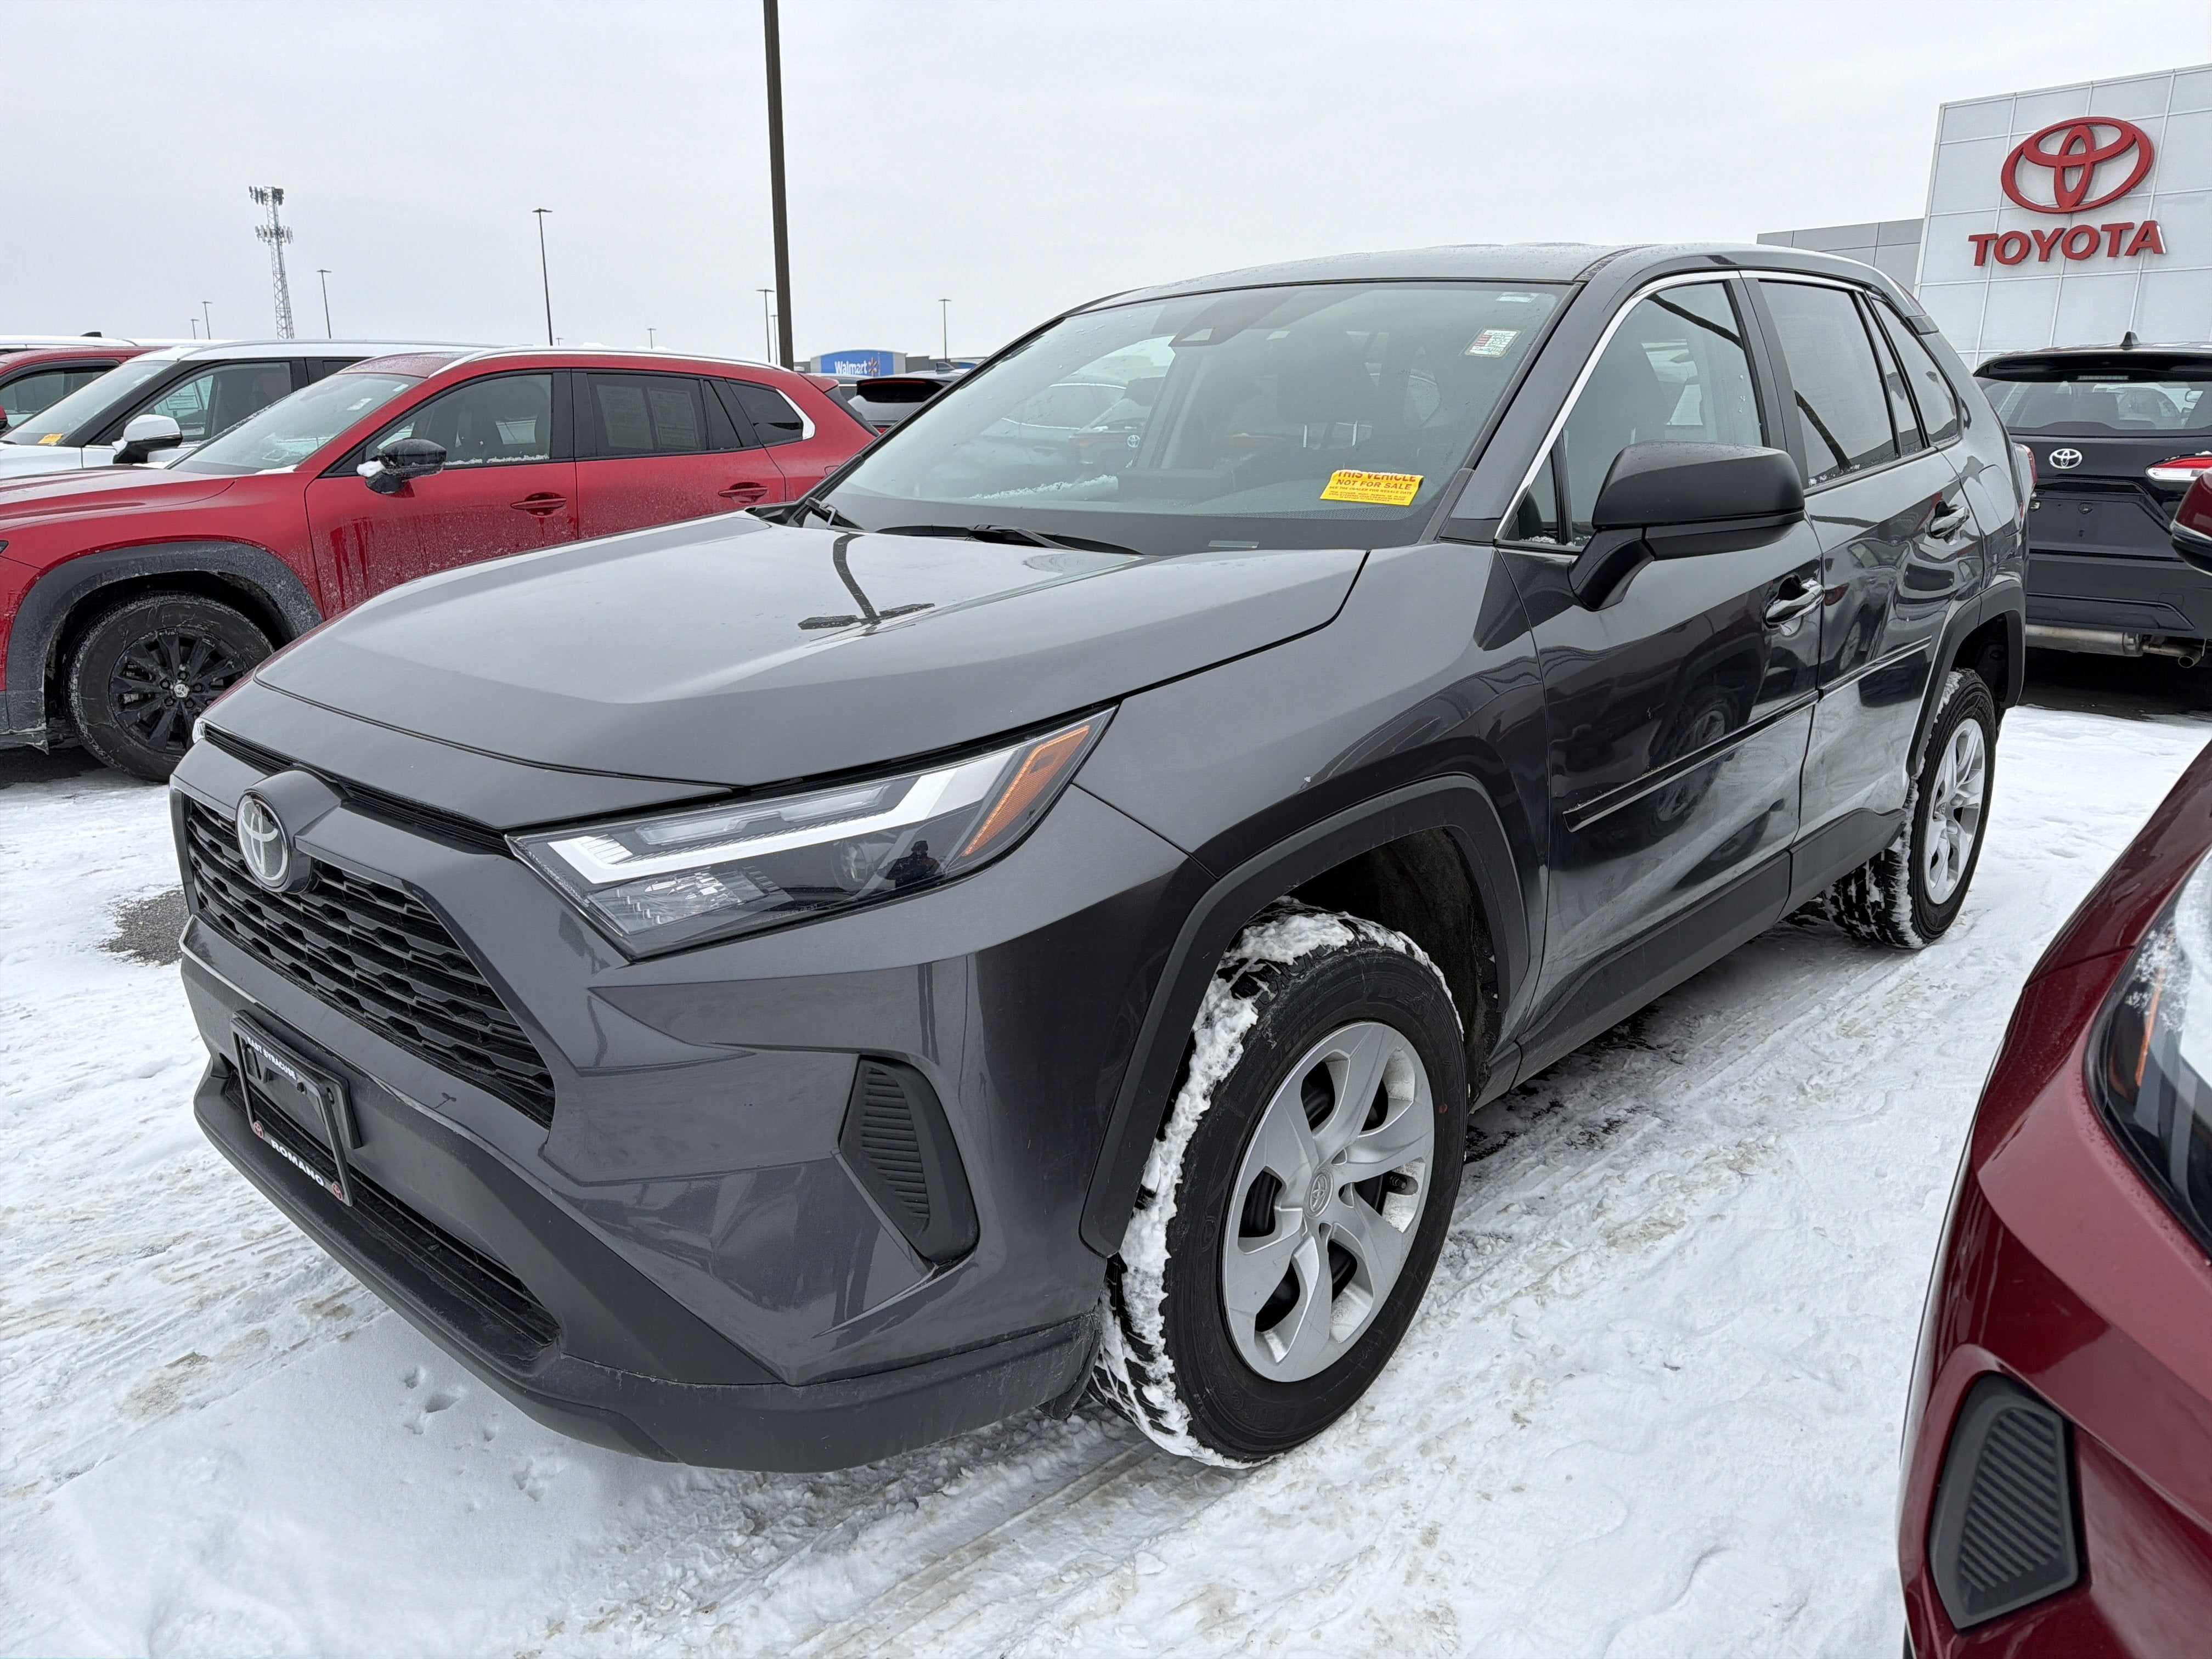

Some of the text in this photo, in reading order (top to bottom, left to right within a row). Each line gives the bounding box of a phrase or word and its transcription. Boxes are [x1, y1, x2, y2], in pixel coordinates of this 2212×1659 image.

[1968, 221, 2166, 266] TOYOTA
[834, 360, 867, 375] Walmart
[1368, 473, 1415, 482] VEHICLE
[246, 1036, 297, 1080] EAST SYRACUSE
[270, 1139, 325, 1187] ROMANO
